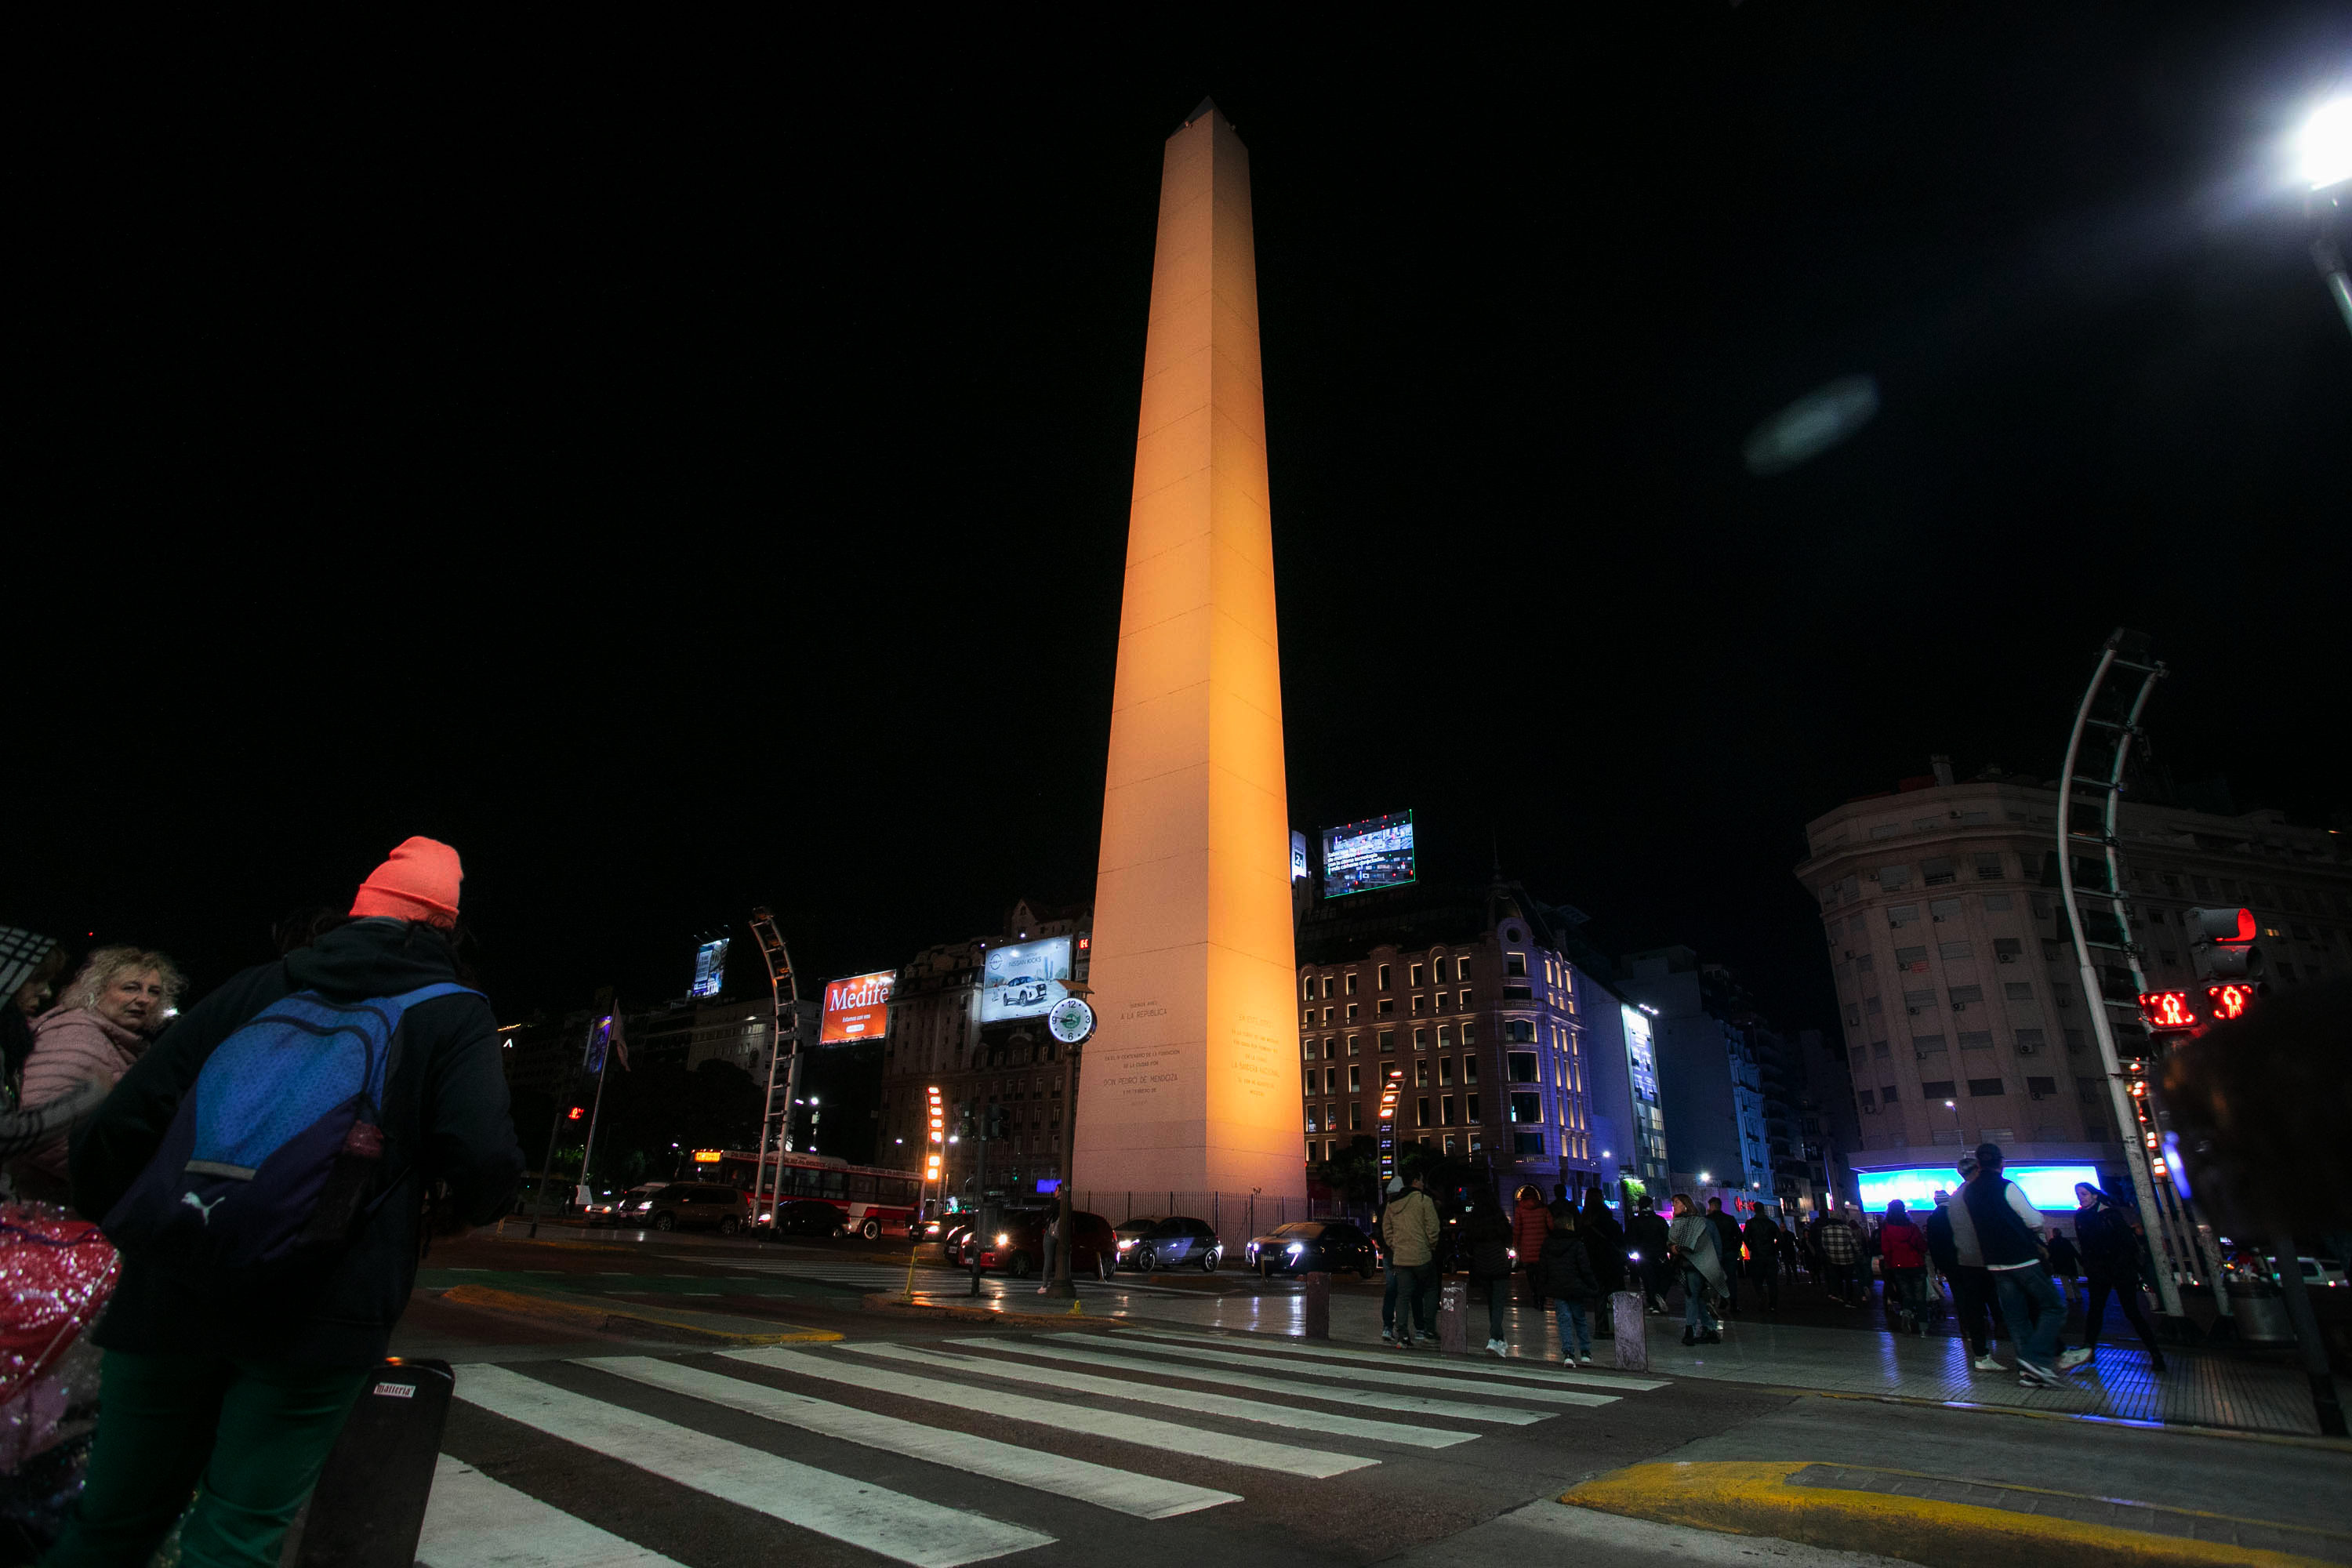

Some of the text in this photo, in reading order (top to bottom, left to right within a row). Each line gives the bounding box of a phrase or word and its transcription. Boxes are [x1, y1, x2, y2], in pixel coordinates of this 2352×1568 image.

[1067, 1000, 1076, 1008] 12
[1118, 1076, 1138, 1085] PEDRO
[1150, 1073, 1178, 1083] MENDOZA
